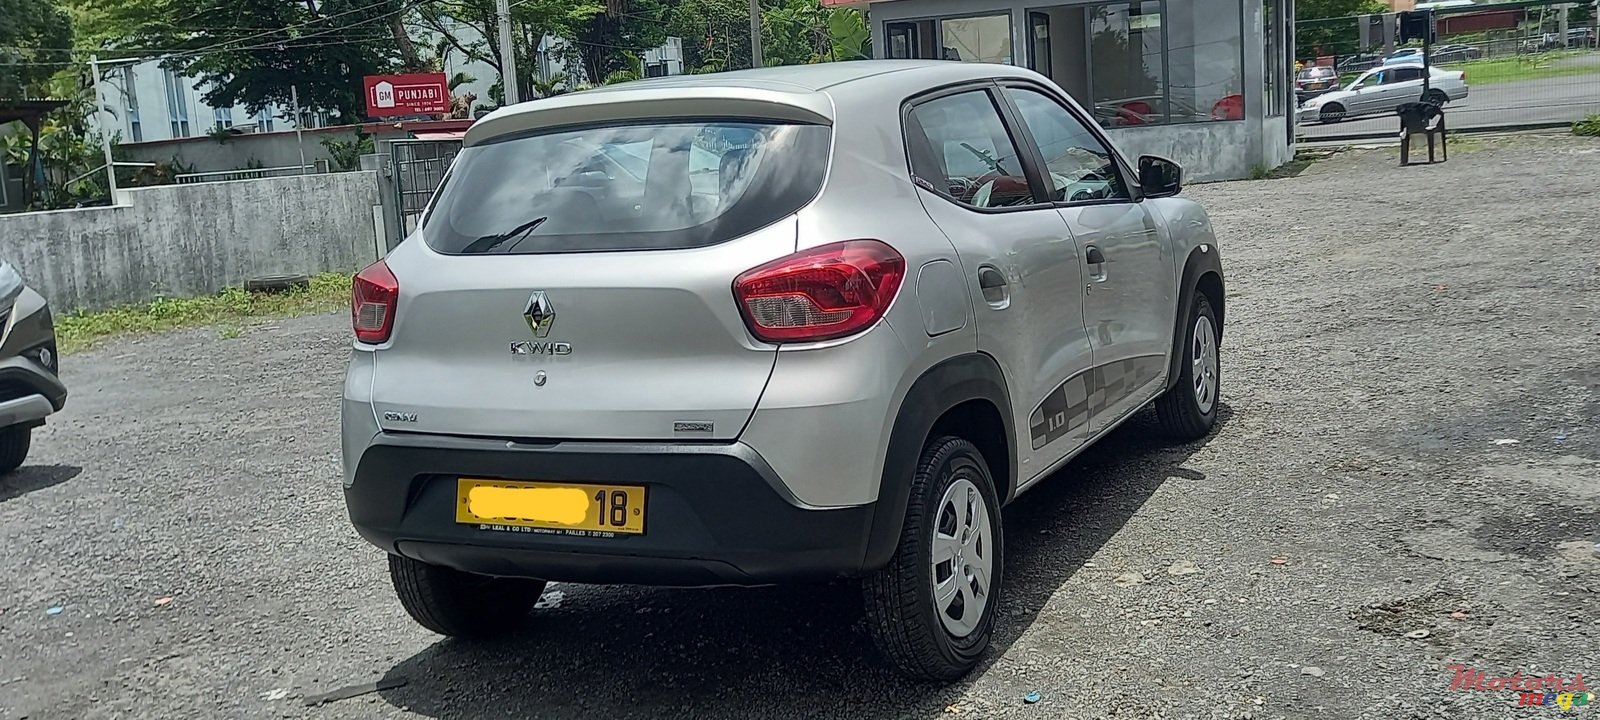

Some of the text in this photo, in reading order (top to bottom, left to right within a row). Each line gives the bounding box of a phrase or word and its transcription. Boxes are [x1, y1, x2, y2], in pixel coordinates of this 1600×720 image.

[379, 91, 392, 101] GM
[398, 88, 438, 100] PUNJABI
[510, 341, 573, 356] KWID
[1048, 410, 1065, 432] 1.0
[594, 489, 628, 527] 18
